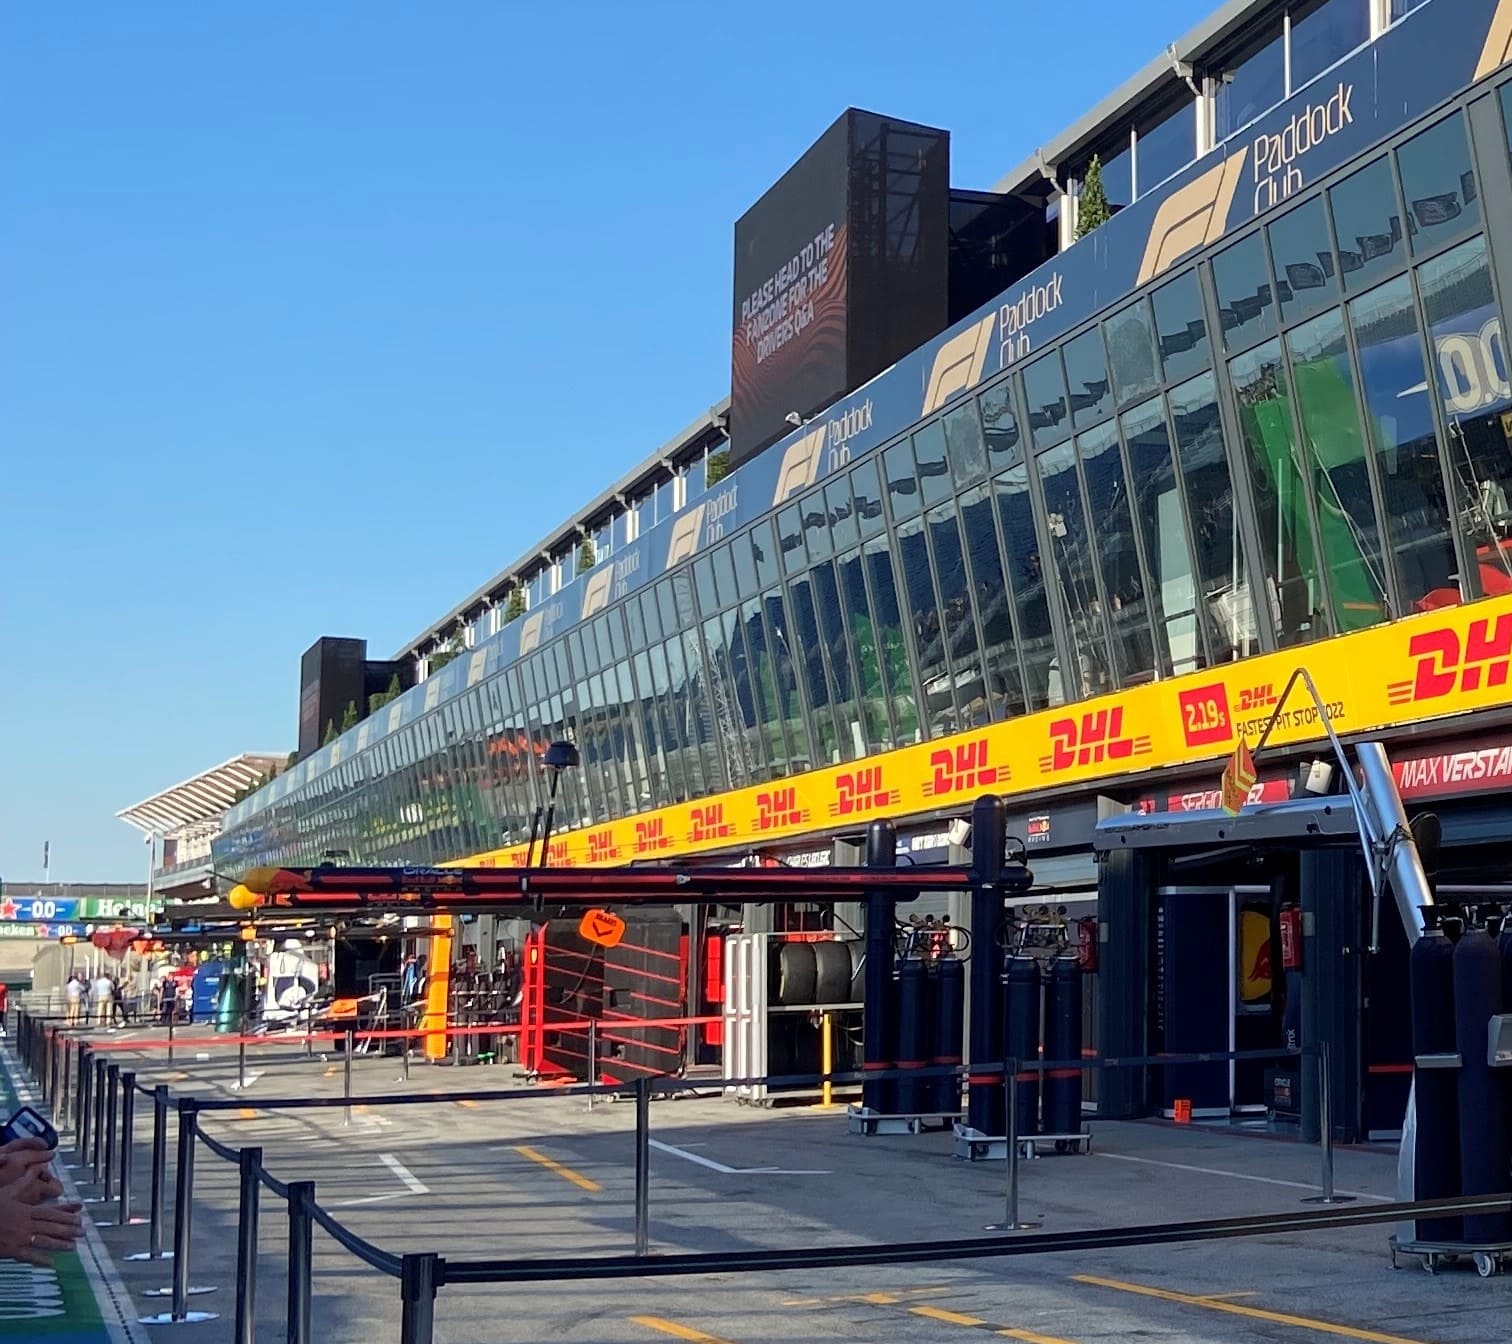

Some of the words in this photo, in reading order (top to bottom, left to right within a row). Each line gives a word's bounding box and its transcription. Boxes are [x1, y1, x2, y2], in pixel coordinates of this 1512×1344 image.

[1254, 82, 1354, 184] Paddock
[741, 278, 774, 321] PLEASE
[775, 256, 800, 297] HEAD
[800, 242, 814, 273] TO
[814, 223, 835, 261] THE
[746, 292, 788, 346] FANZONE
[788, 276, 809, 312] FOR
[808, 258, 828, 295] THE
[999, 271, 1063, 342] Paddock
[757, 315, 794, 365] DRIVERS
[828, 398, 873, 450] Paddock
[1239, 683, 1278, 712] DHL
[1276, 712, 1293, 731] PIT
[1294, 707, 1319, 728] STOP
[1320, 701, 1346, 722] 022
[1049, 706, 1134, 771] DHL
[836, 766, 890, 816] DHL
[930, 739, 998, 795] DHL
[1400, 755, 1441, 789] MAX
[690, 803, 729, 843] DHL
[756, 787, 802, 831] DHL
[588, 830, 618, 864] DHL
[636, 817, 668, 854] DHL
